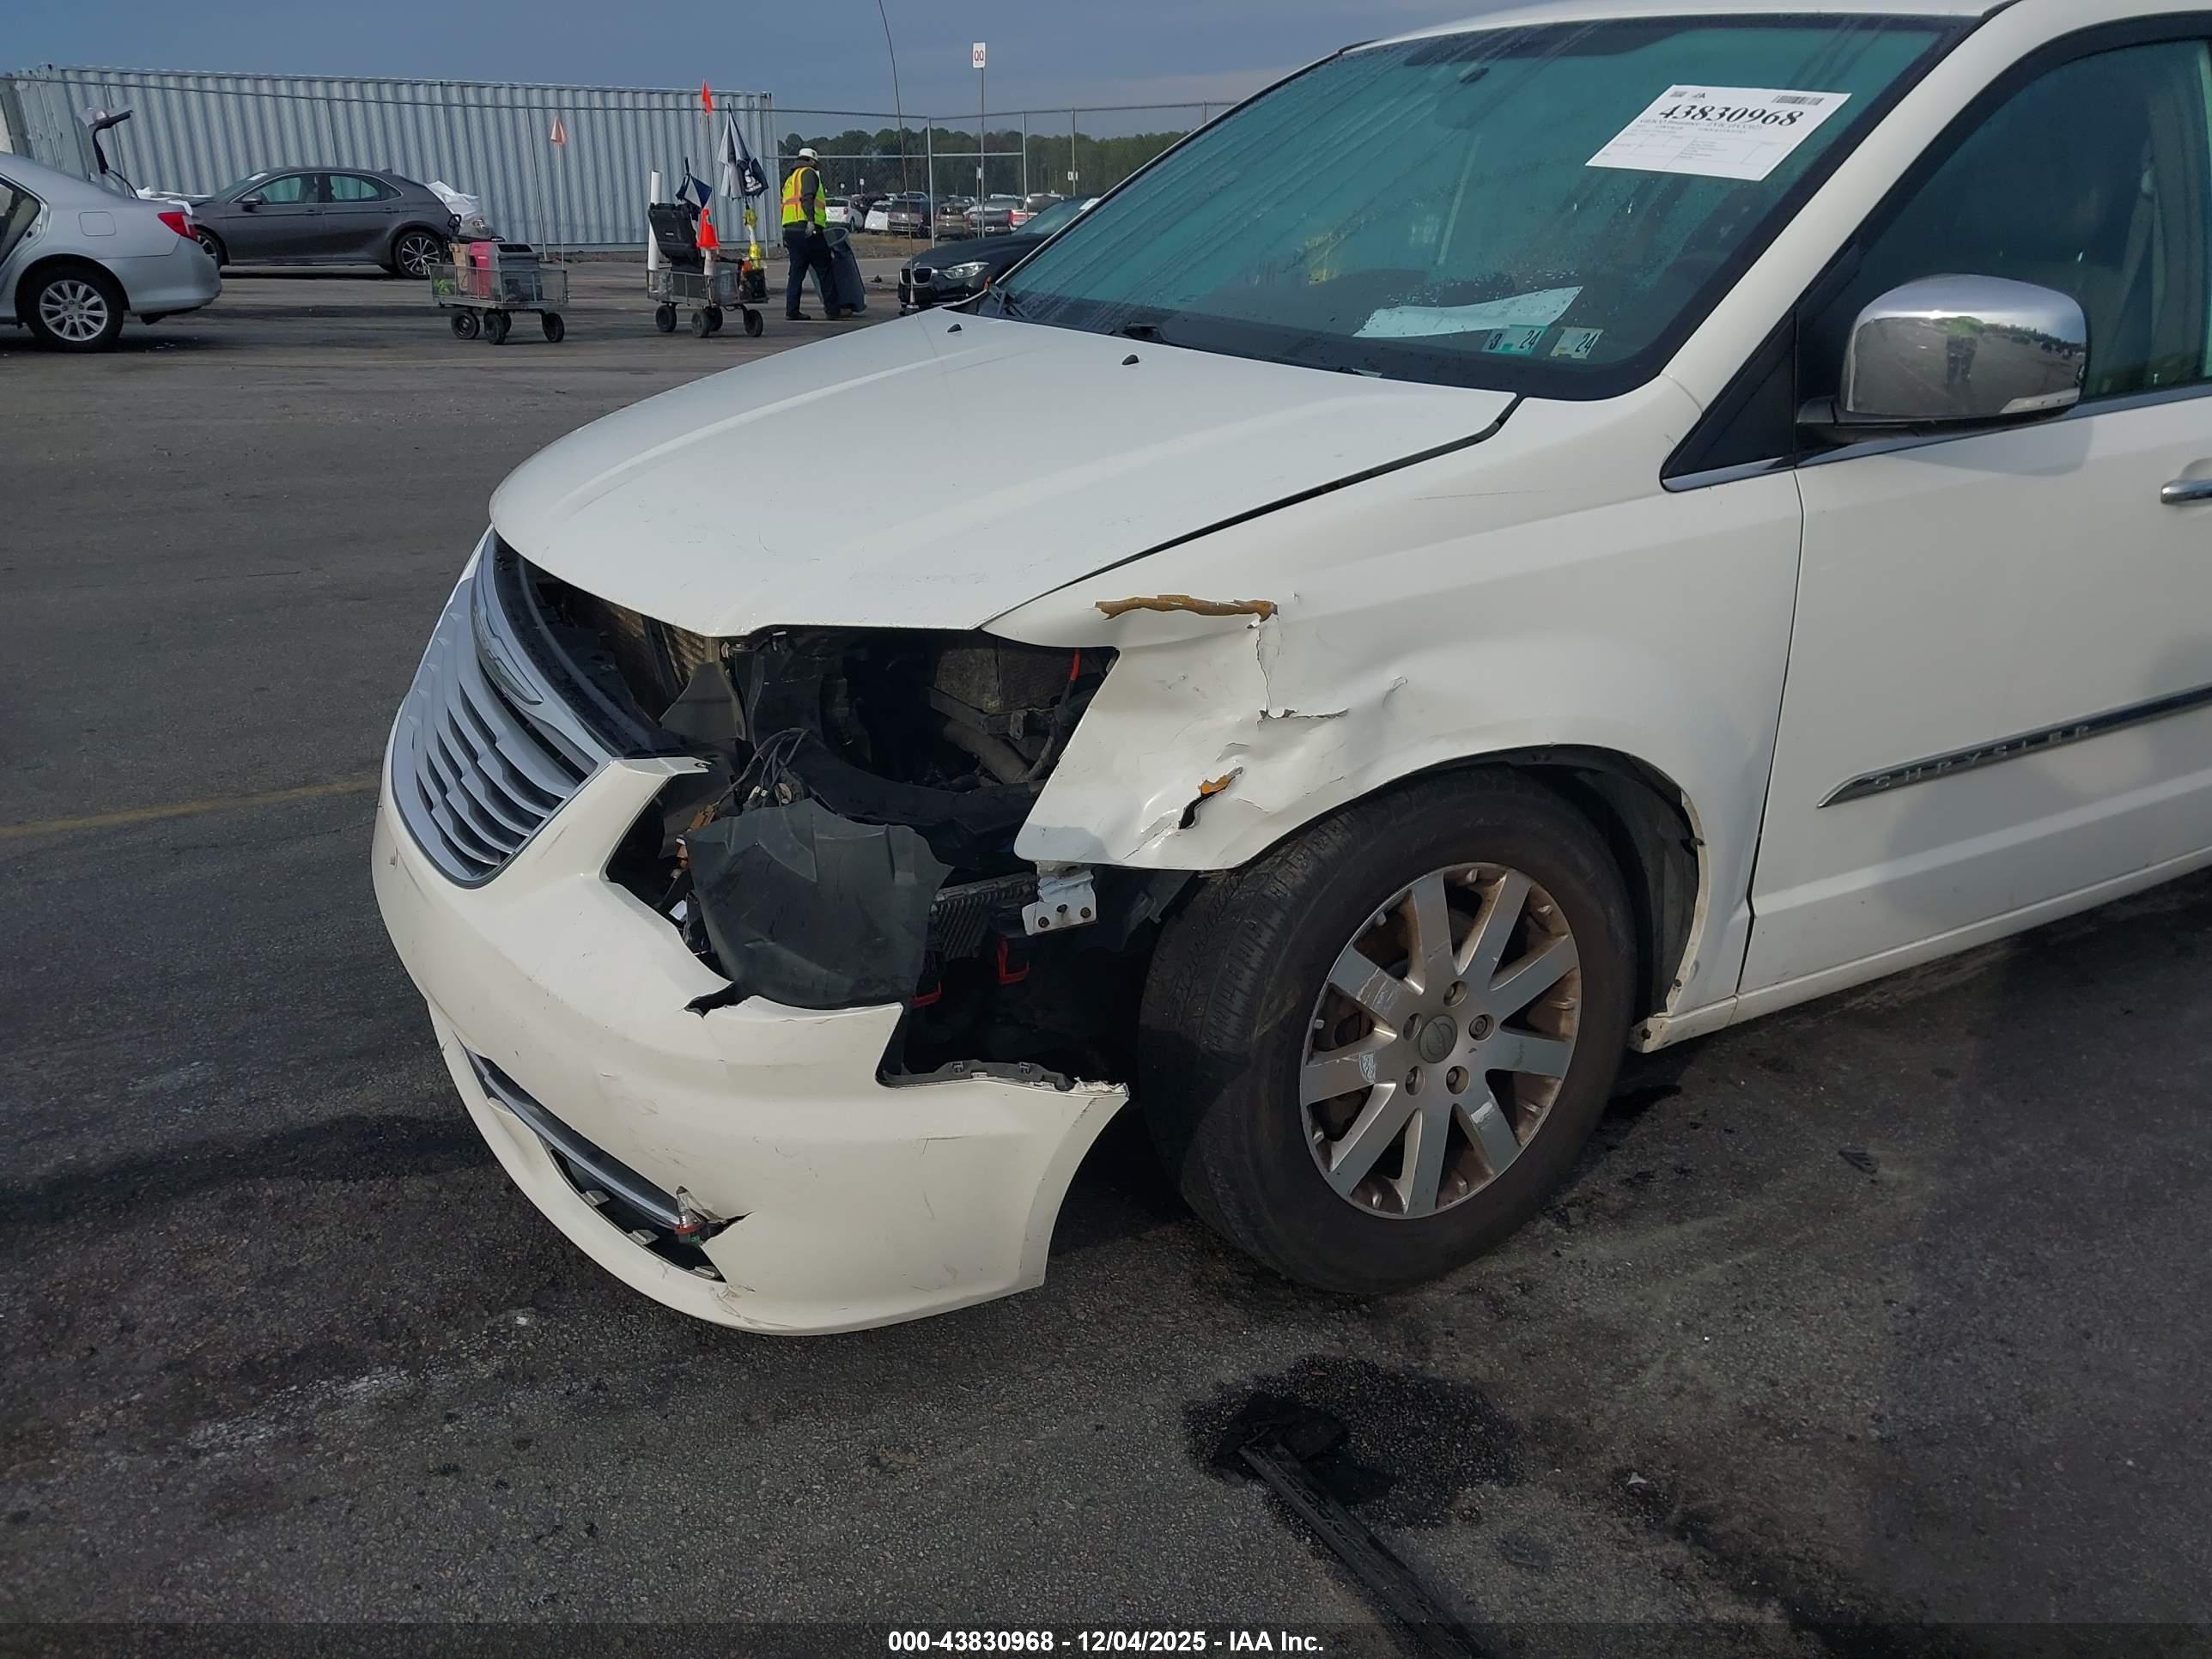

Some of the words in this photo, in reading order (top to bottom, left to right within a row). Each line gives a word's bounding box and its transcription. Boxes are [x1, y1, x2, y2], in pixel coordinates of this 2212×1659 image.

[1659, 103, 1803, 127] 43830968
[1488, 333, 1503, 350] 3
[1519, 329, 1542, 349] 24
[1574, 332, 1598, 353] 24
[1875, 725, 2089, 788] CHRYSLER
